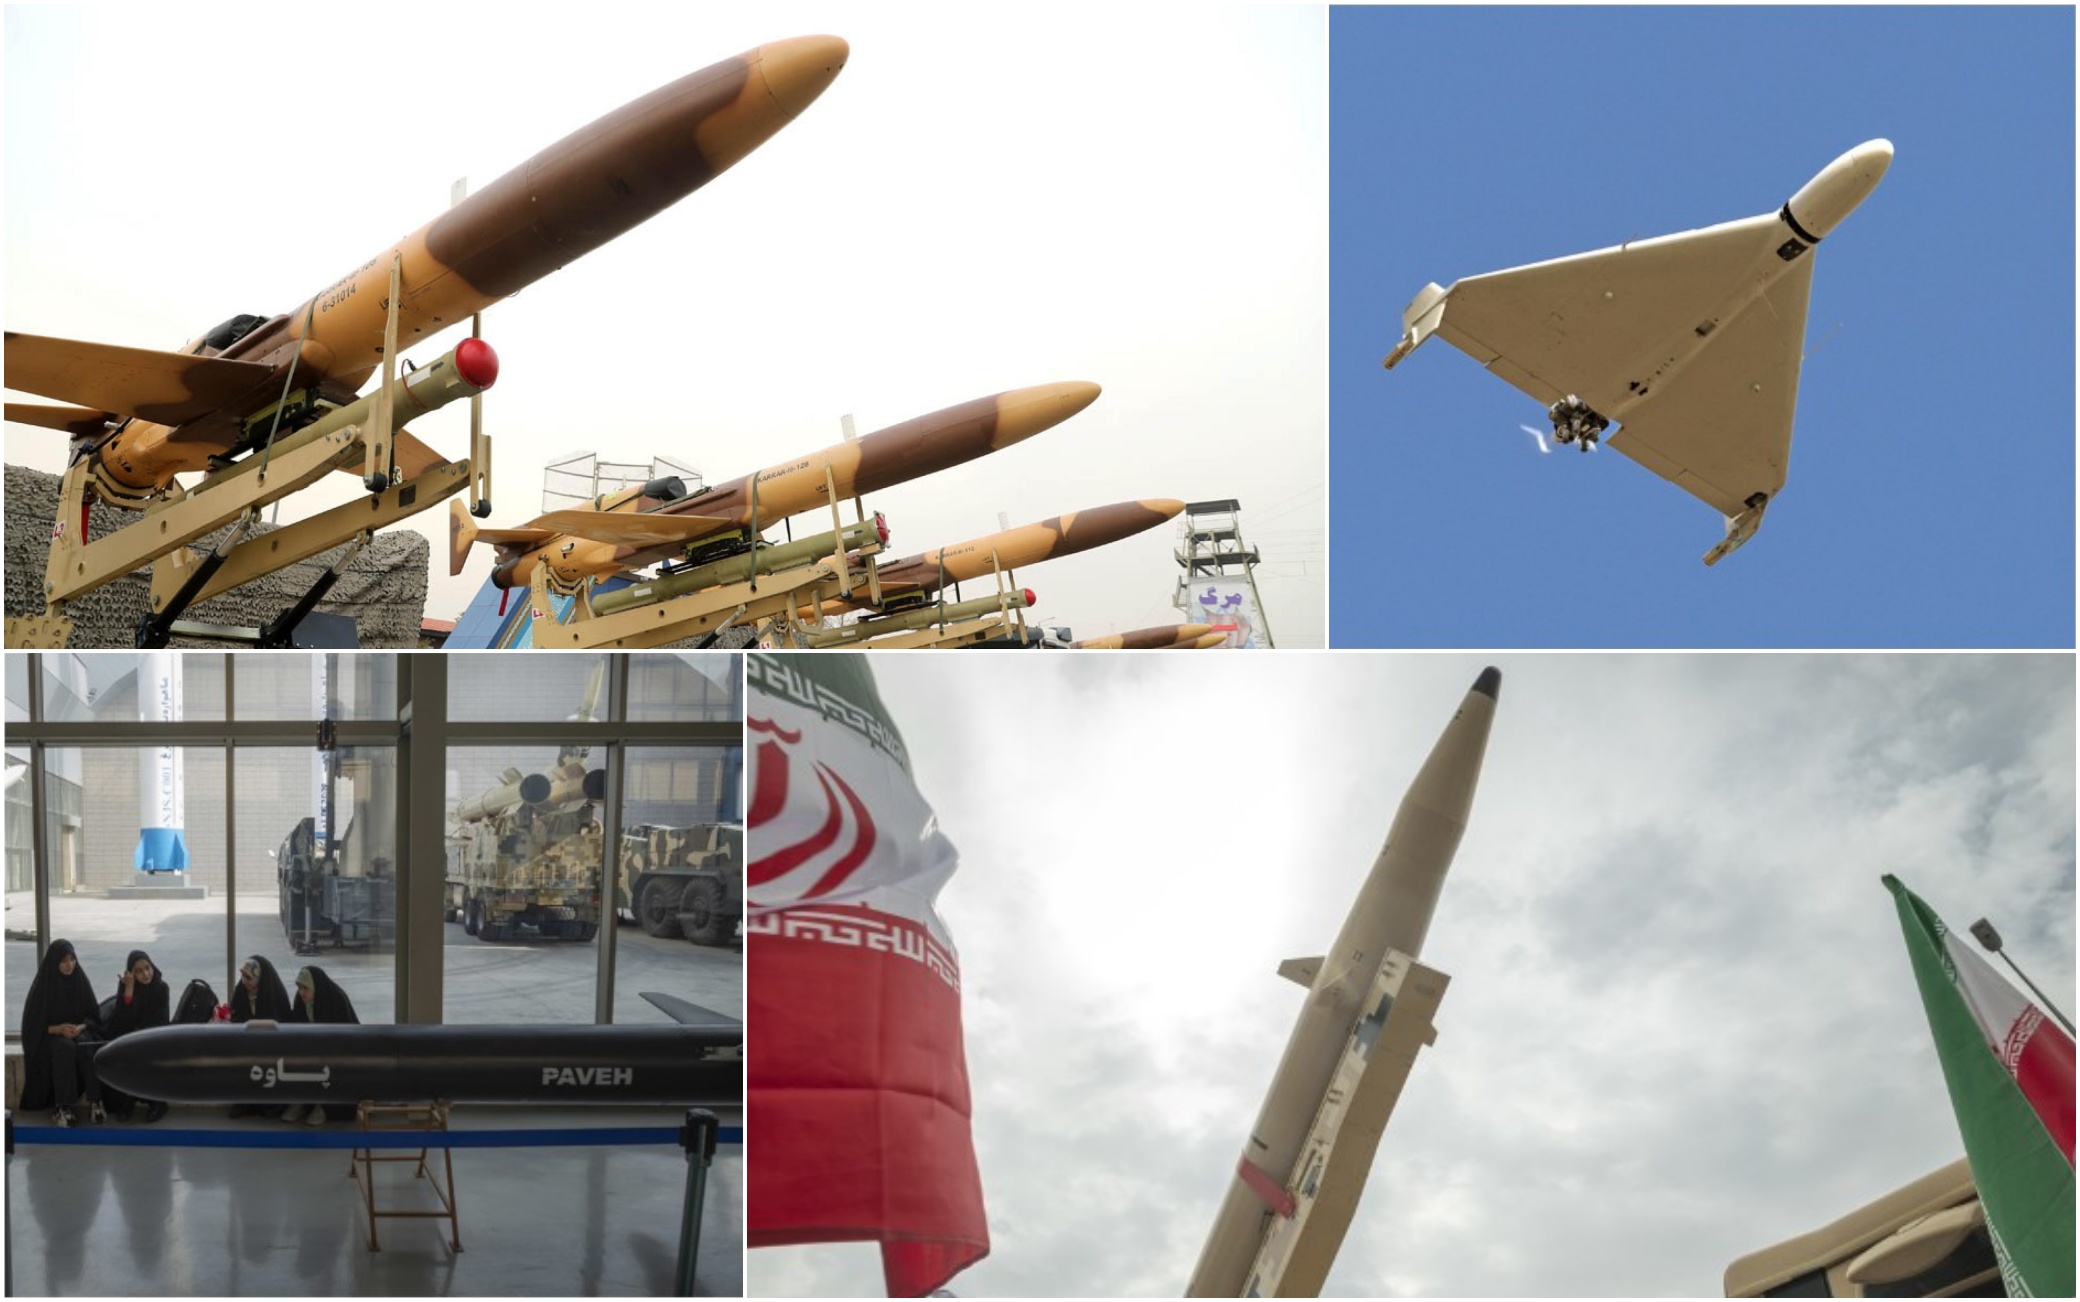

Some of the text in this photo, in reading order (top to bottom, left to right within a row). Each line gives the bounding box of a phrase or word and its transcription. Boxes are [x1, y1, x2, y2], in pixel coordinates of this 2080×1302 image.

[322, 283, 356, 312] 6-31014
[1199, 586, 1242, 608] مرگ
[250, 1057, 331, 1089] پاوه
[542, 1067, 632, 1086] PAVEH
